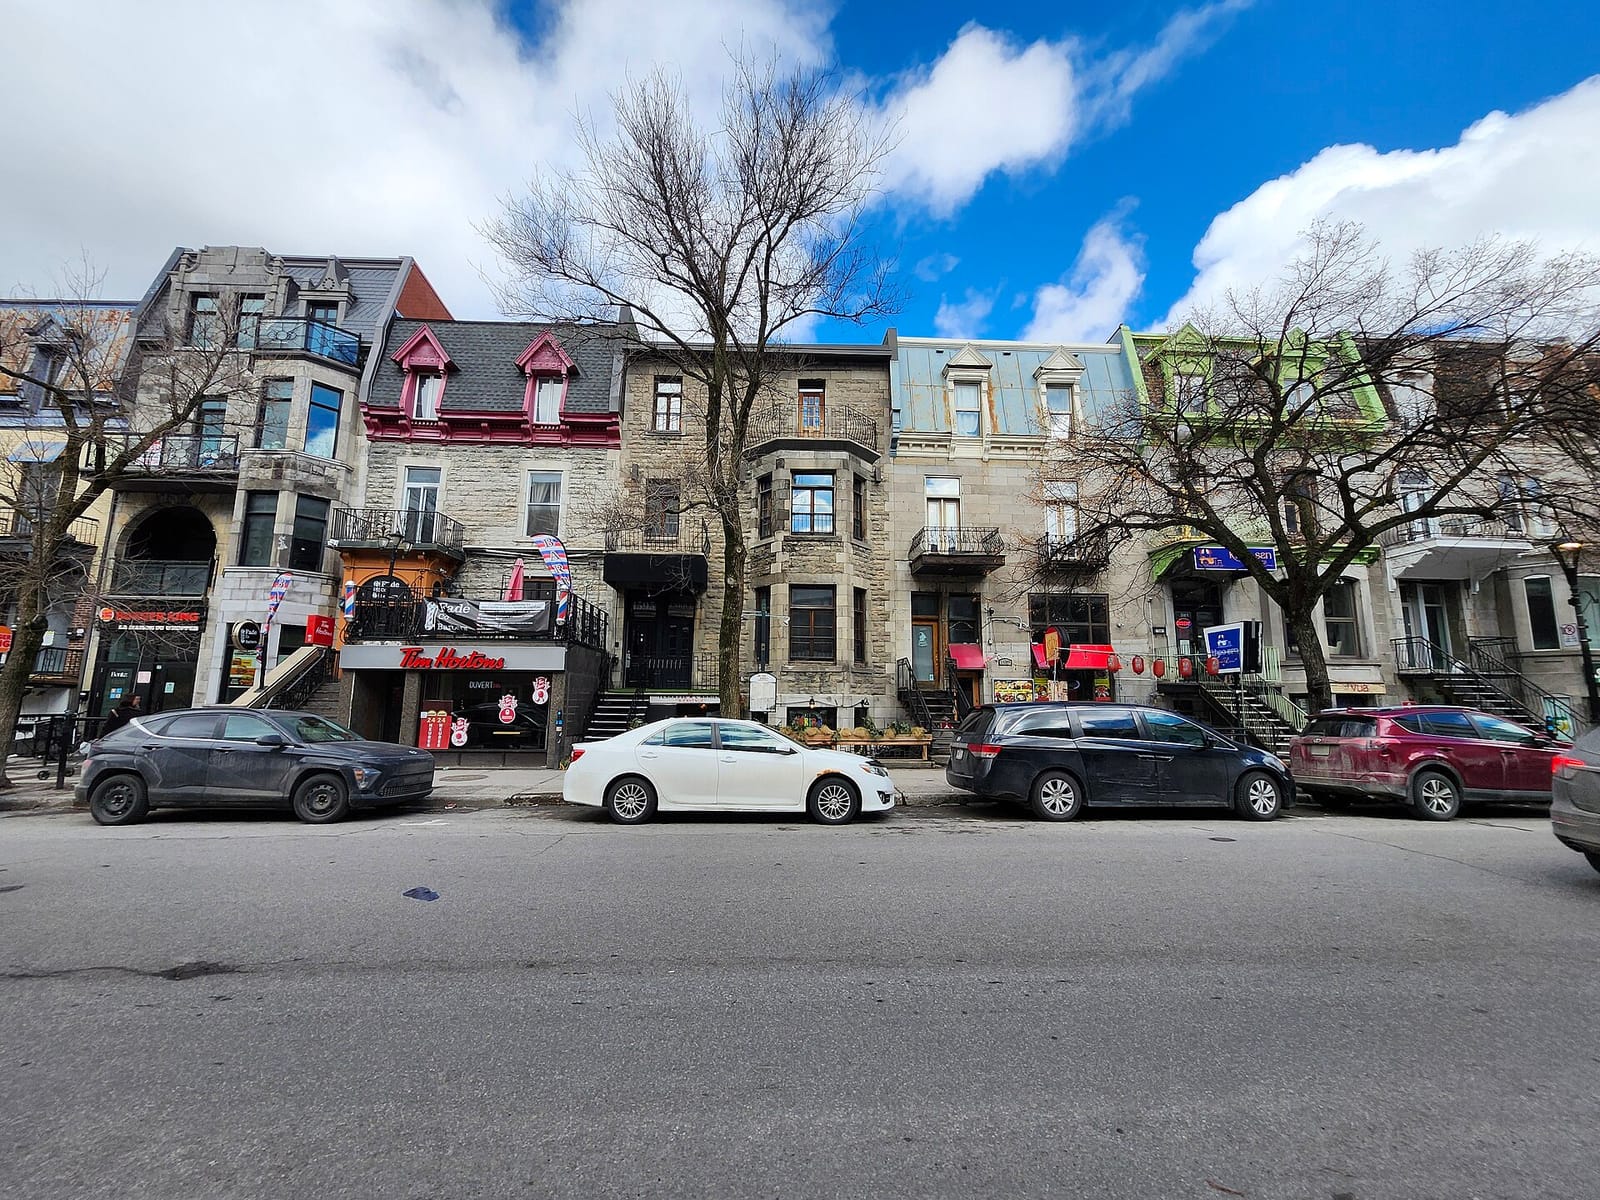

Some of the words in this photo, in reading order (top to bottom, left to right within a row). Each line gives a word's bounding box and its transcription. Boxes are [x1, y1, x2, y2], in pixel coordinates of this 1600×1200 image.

[439, 602, 471, 615] Fade
[400, 647, 434, 669] Tim
[434, 646, 506, 670] Hortons
